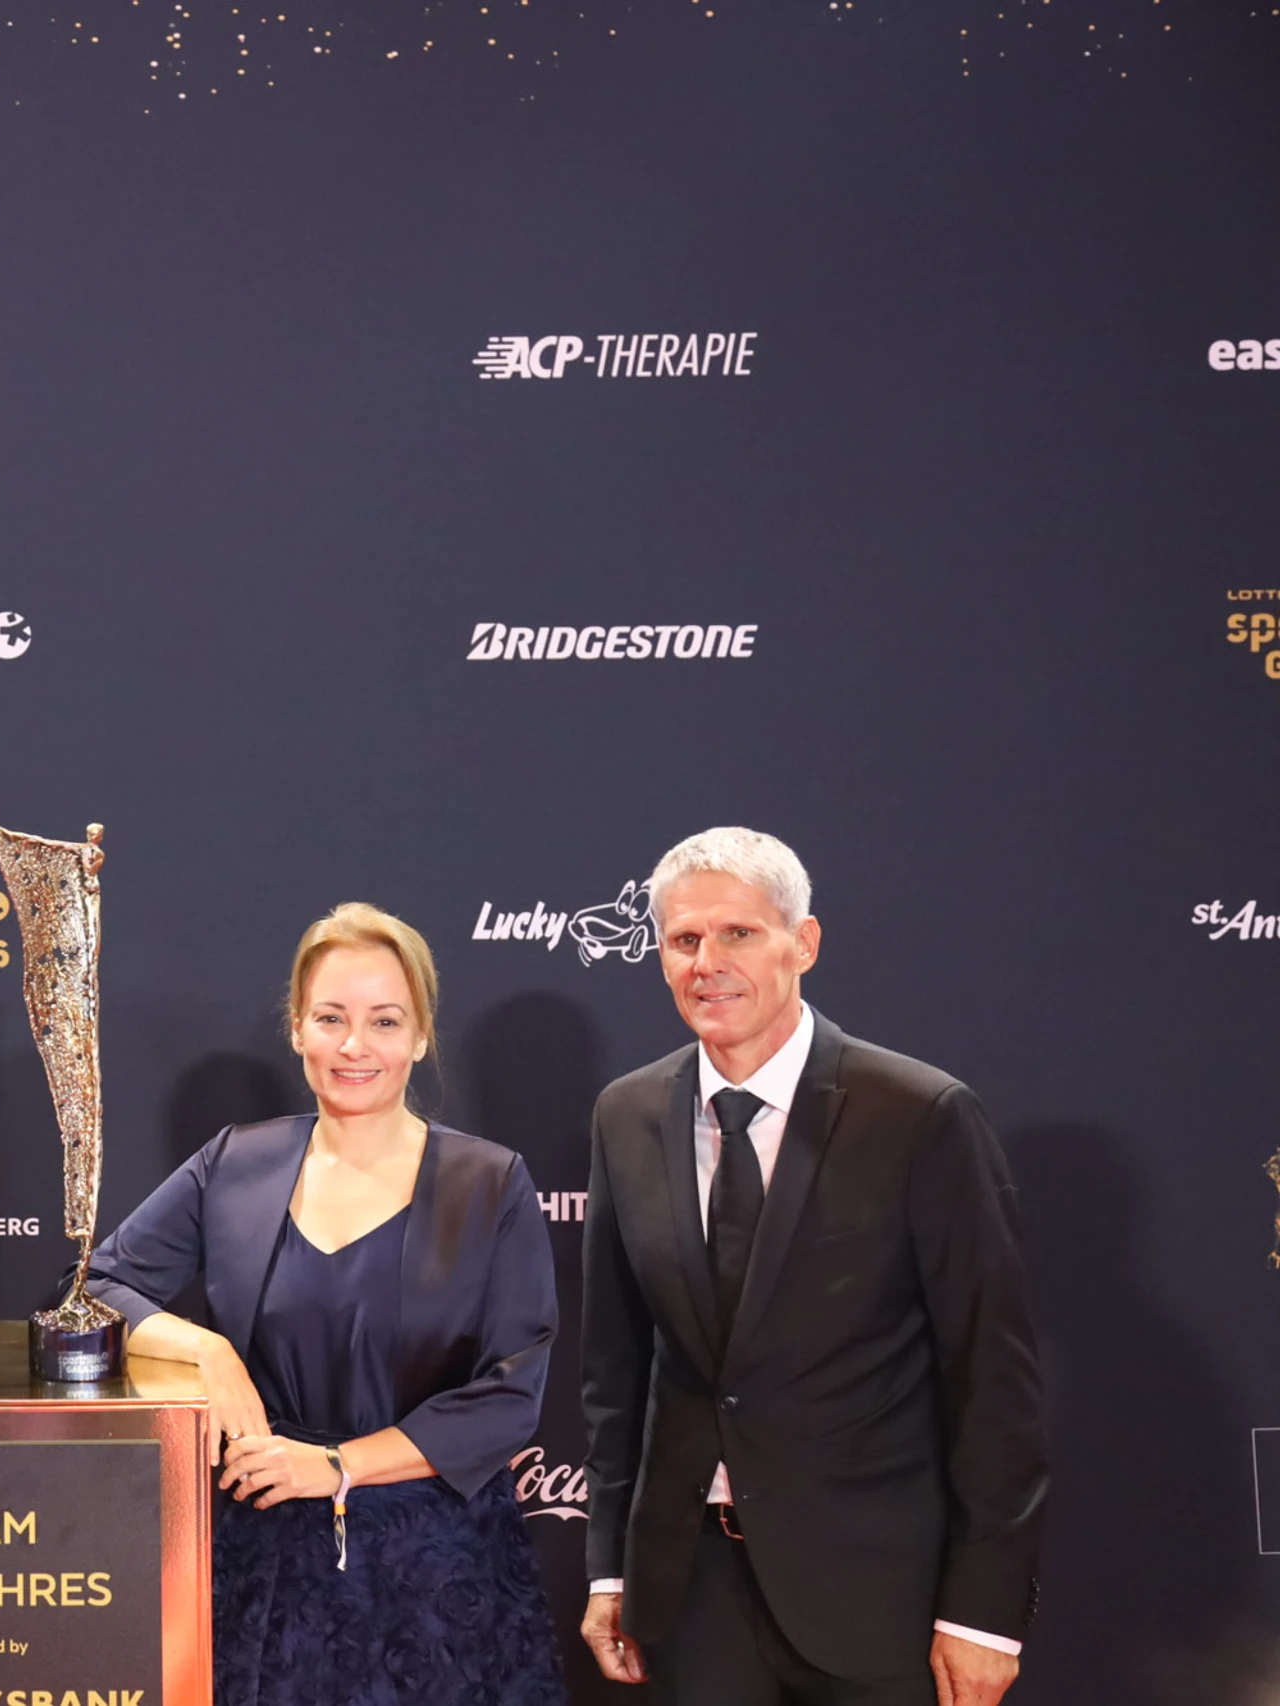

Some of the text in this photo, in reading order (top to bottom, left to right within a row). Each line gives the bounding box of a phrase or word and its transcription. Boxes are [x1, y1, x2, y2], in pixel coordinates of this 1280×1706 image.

[472, 333, 758, 378] ACP-THERAPIE
[1228, 590, 1280, 600] LOTT
[467, 623, 758, 660] BRIDGESTONE
[472, 901, 568, 951] Lucky
[9, 1639, 29, 1656] by
